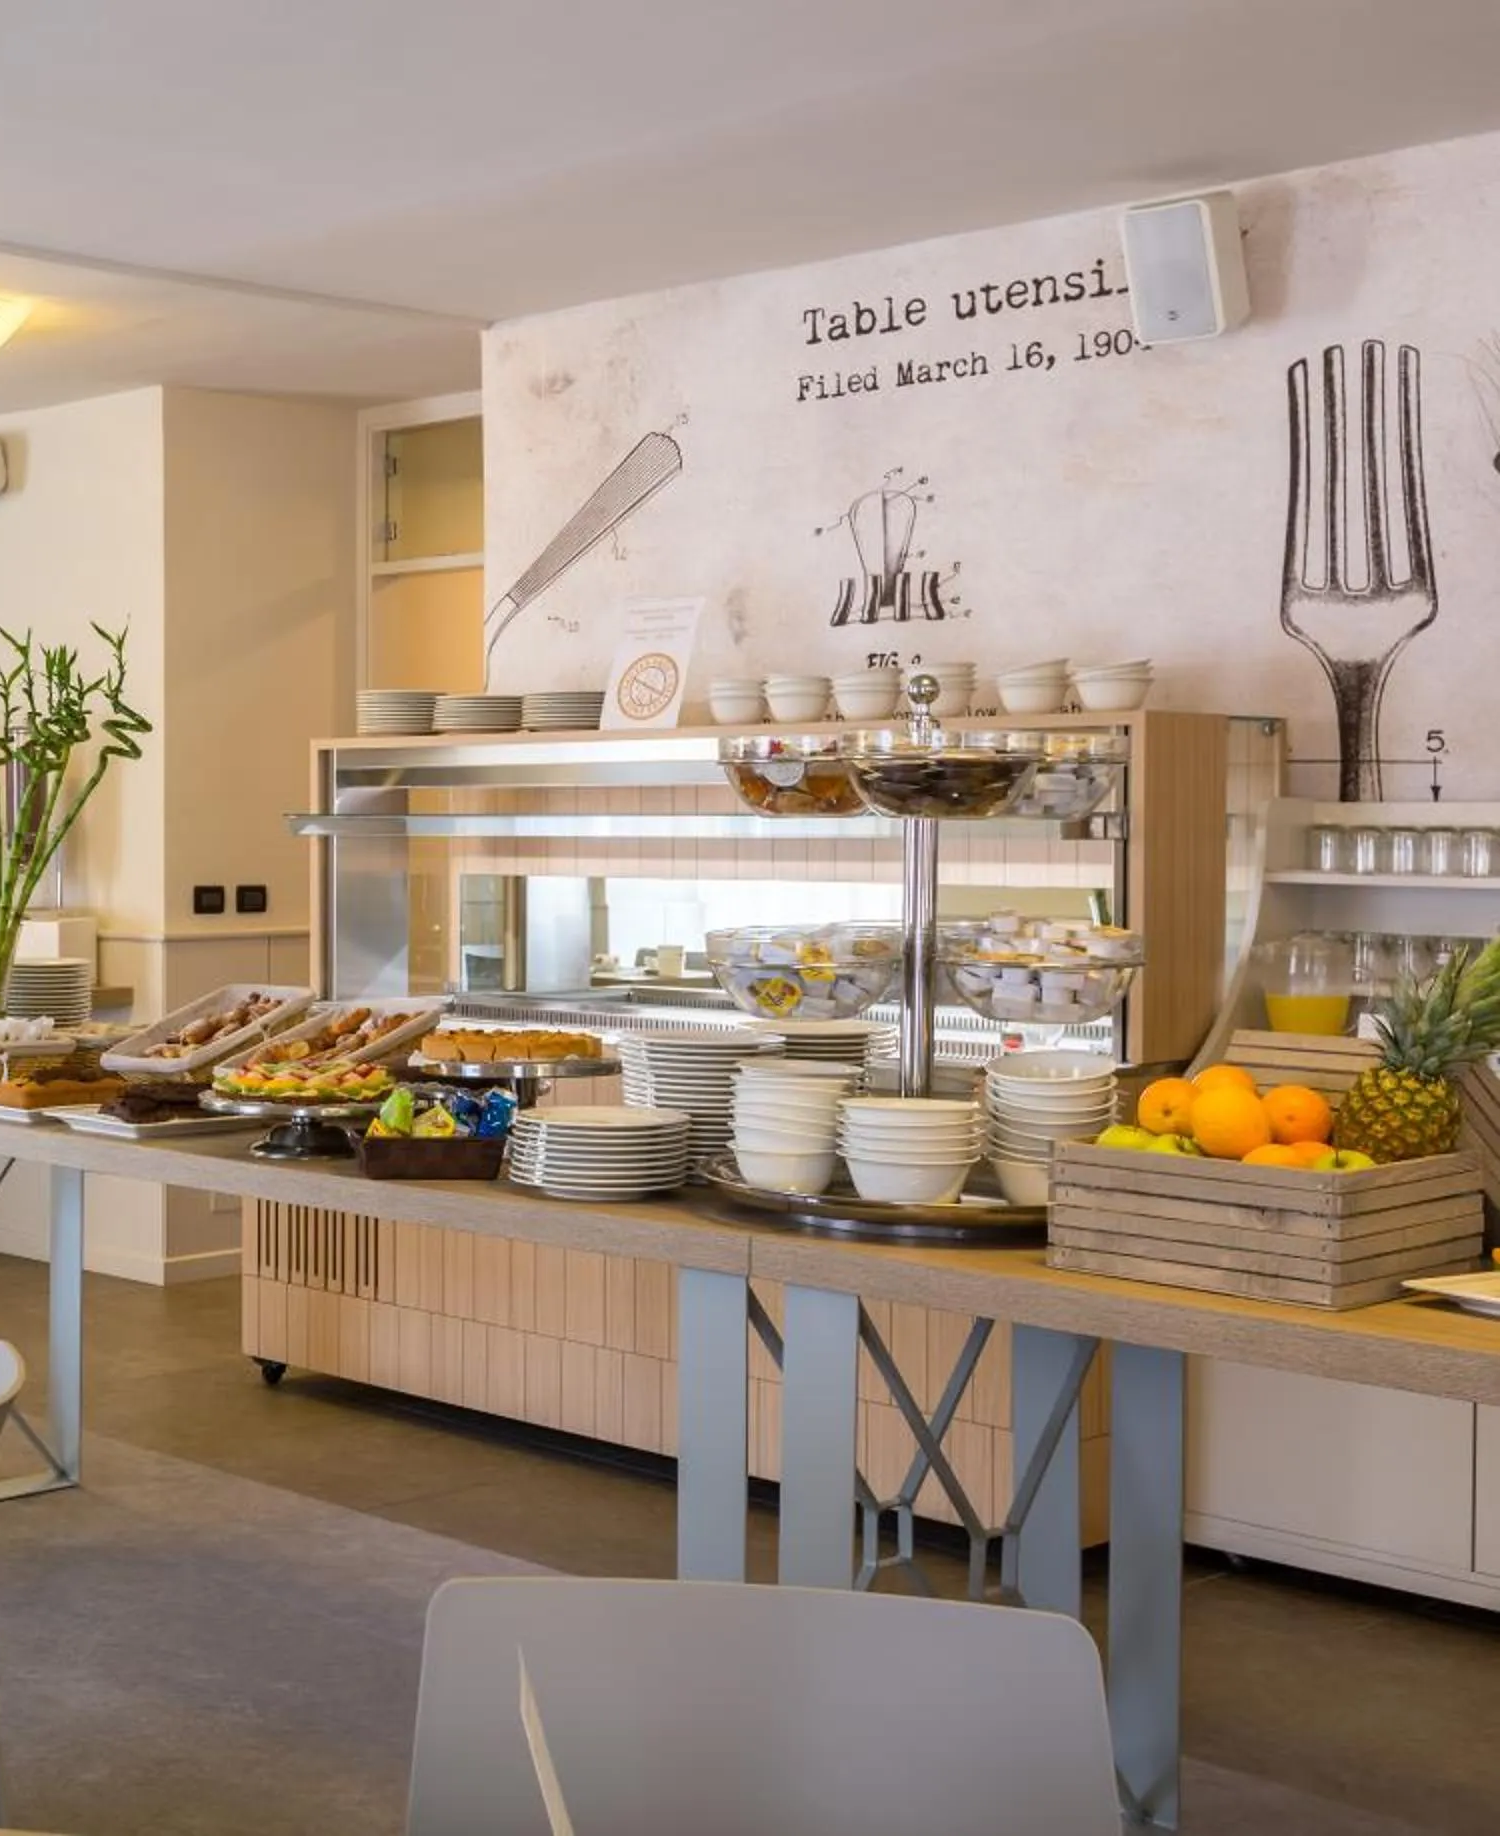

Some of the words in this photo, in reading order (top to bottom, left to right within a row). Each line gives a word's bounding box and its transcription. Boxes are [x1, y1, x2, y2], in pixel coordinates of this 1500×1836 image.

[803, 296, 927, 345] Table
[797, 368, 879, 402] Filed
[896, 351, 989, 388] March
[1006, 341, 1056, 371] 16,
[1074, 328, 1152, 362] 190
